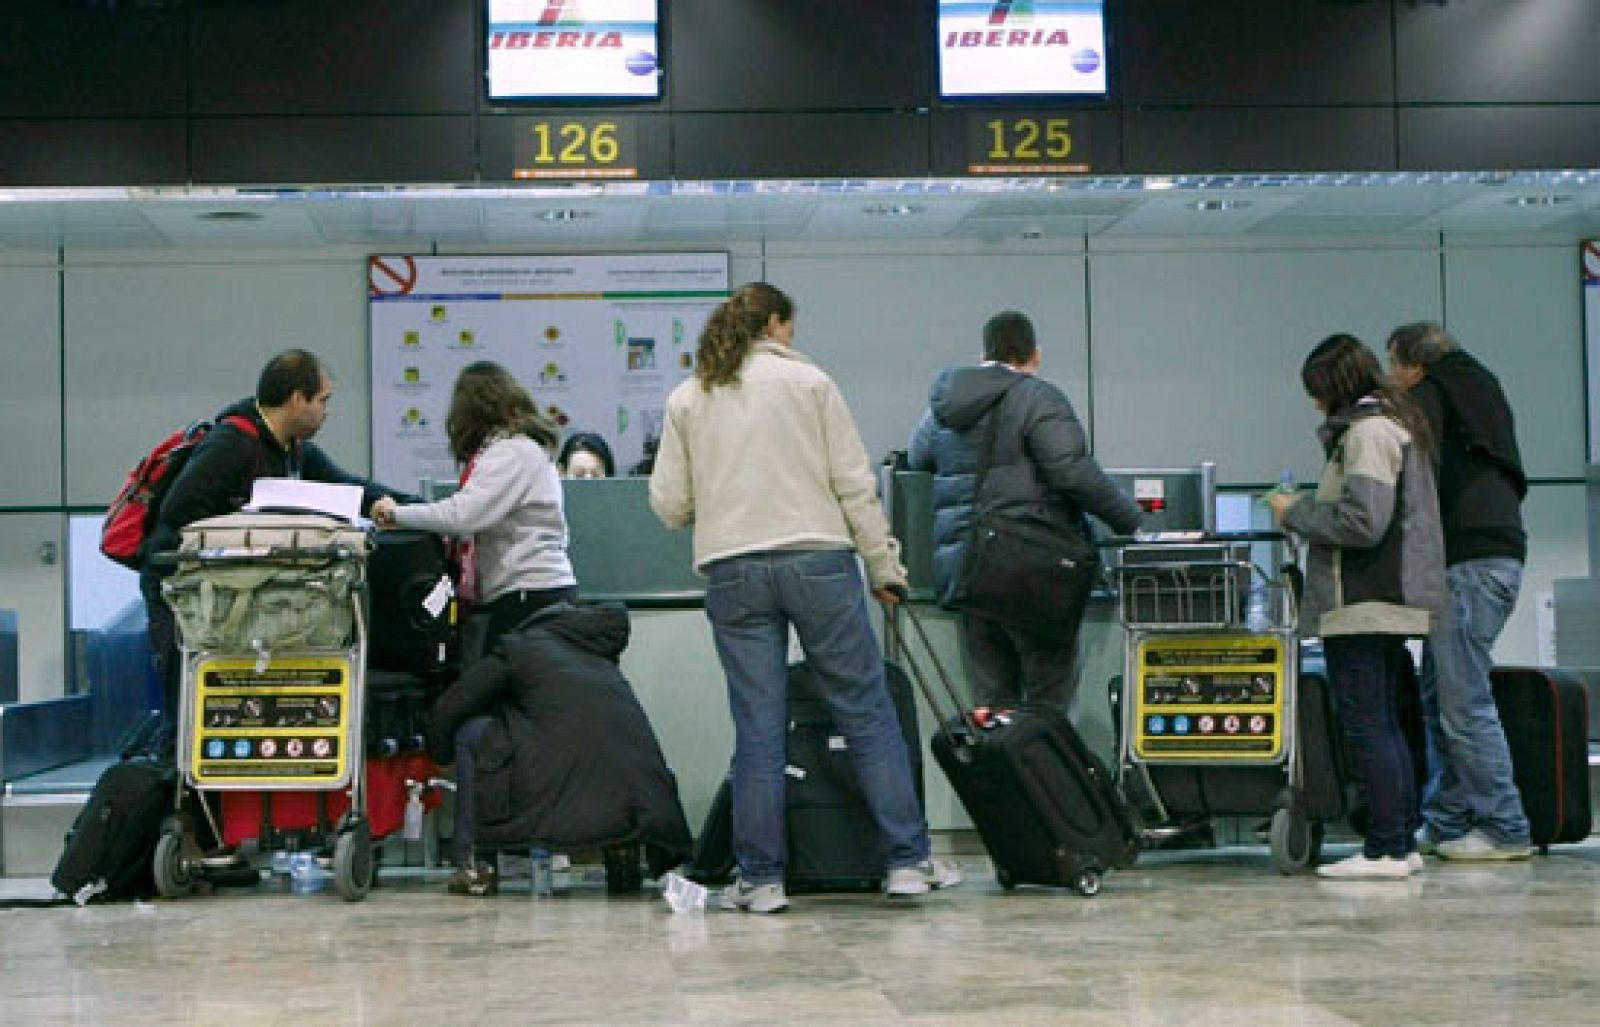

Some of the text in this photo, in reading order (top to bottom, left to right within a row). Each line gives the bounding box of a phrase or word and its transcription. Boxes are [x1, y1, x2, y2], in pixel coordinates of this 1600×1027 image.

[491, 31, 623, 49] IBERIA
[945, 29, 1069, 47] IBERIA
[533, 122, 619, 163] 126
[987, 119, 1072, 159] 125
